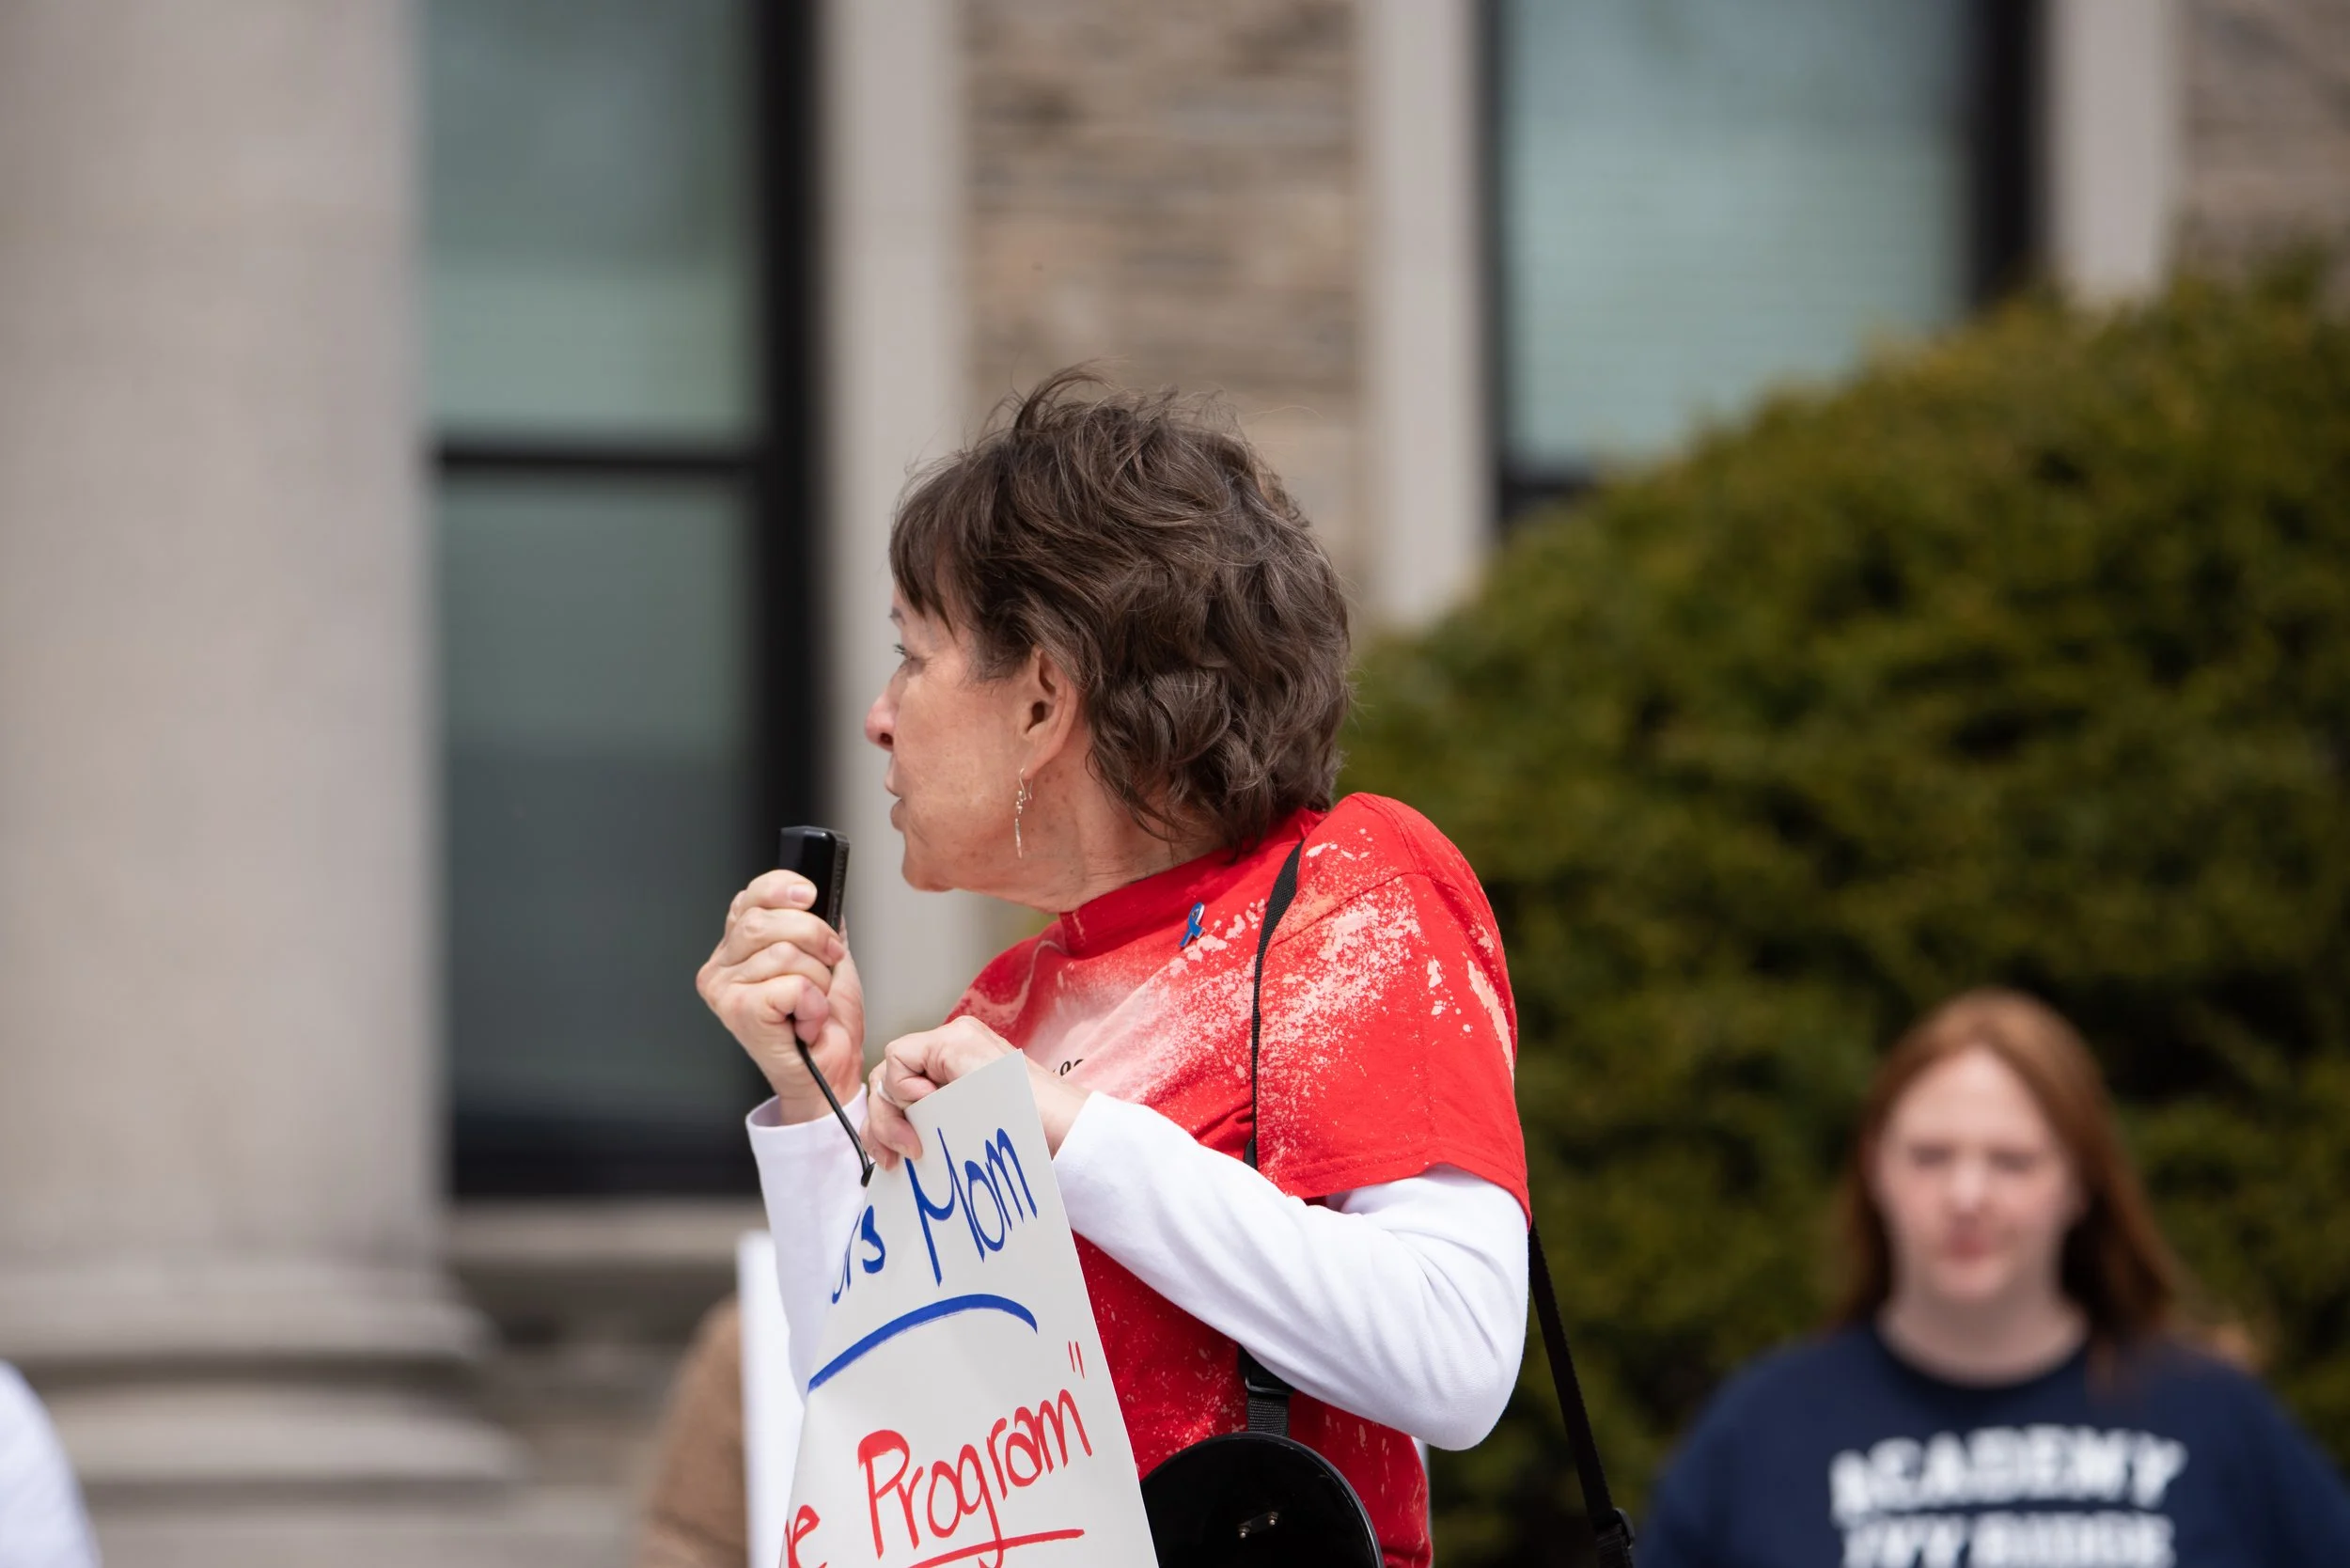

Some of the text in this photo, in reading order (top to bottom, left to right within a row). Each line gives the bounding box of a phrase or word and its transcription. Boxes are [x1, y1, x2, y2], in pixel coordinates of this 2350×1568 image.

[905, 1128, 1038, 1288] Mom
[1829, 1423, 2188, 1530] ACADEMY
[782, 1504, 827, 1568] e
